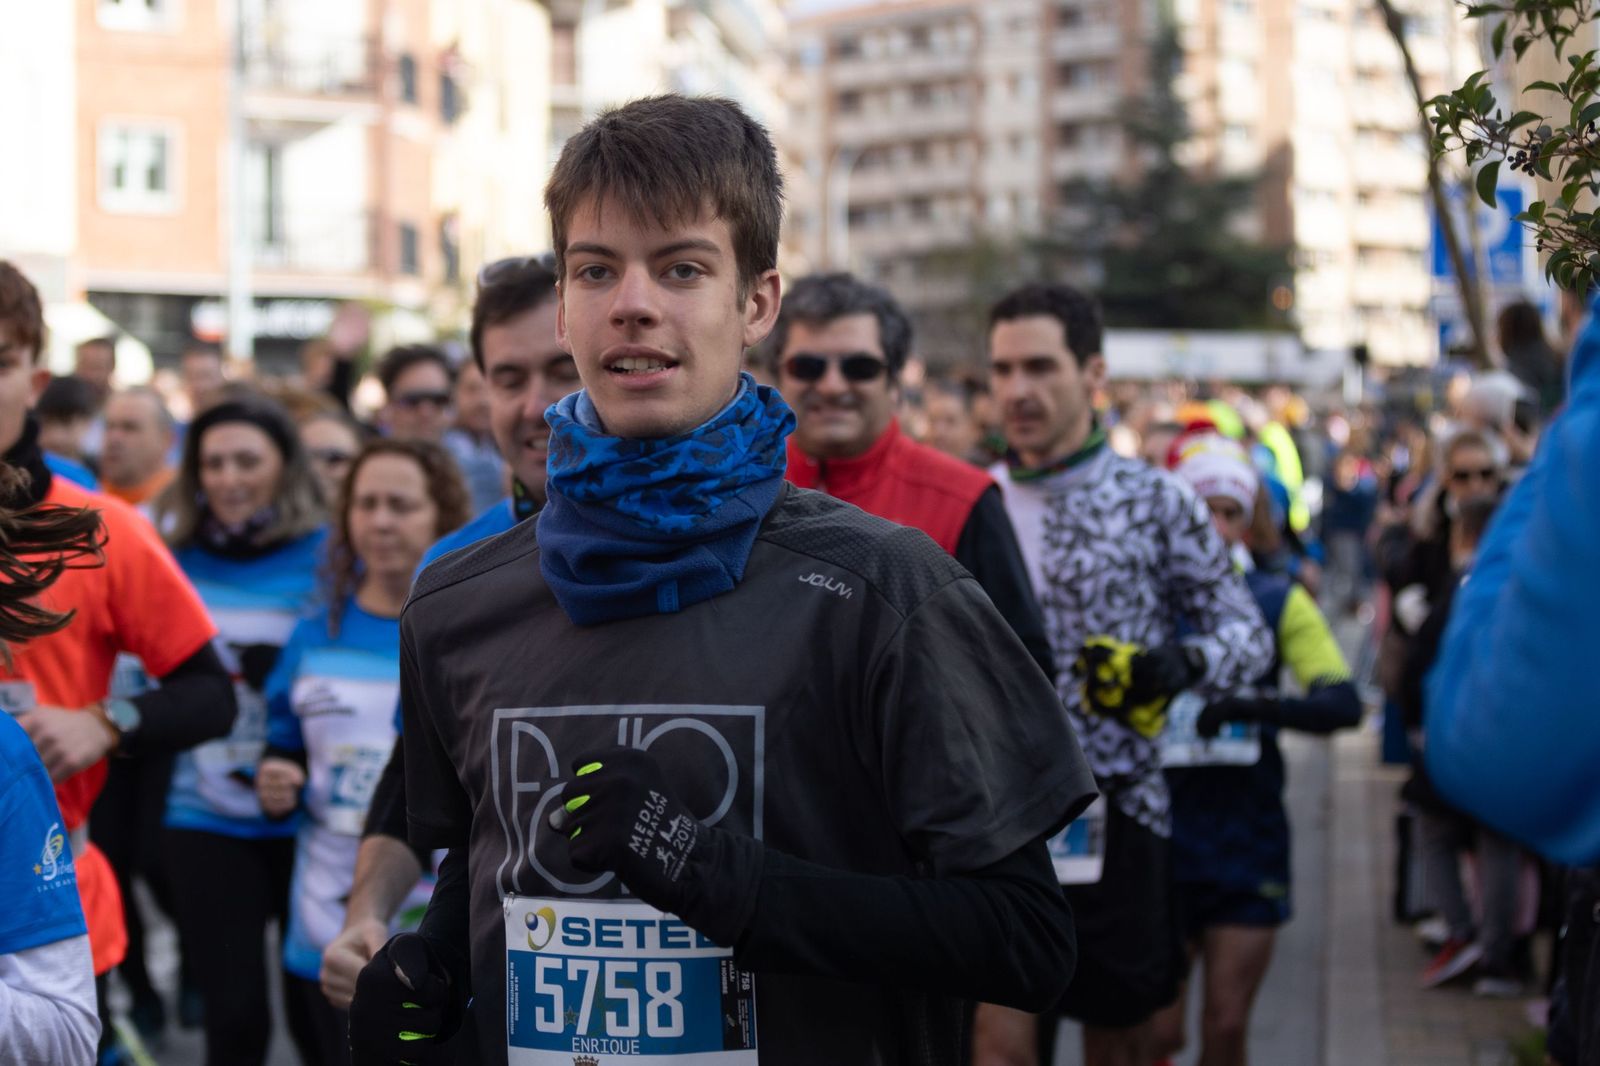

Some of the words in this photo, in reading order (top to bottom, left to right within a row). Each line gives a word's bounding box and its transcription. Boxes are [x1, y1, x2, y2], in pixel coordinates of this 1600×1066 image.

[628, 790, 660, 853] MEDIA
[534, 956, 685, 1038] 5758
[572, 1037, 640, 1055] ENRIQUE
